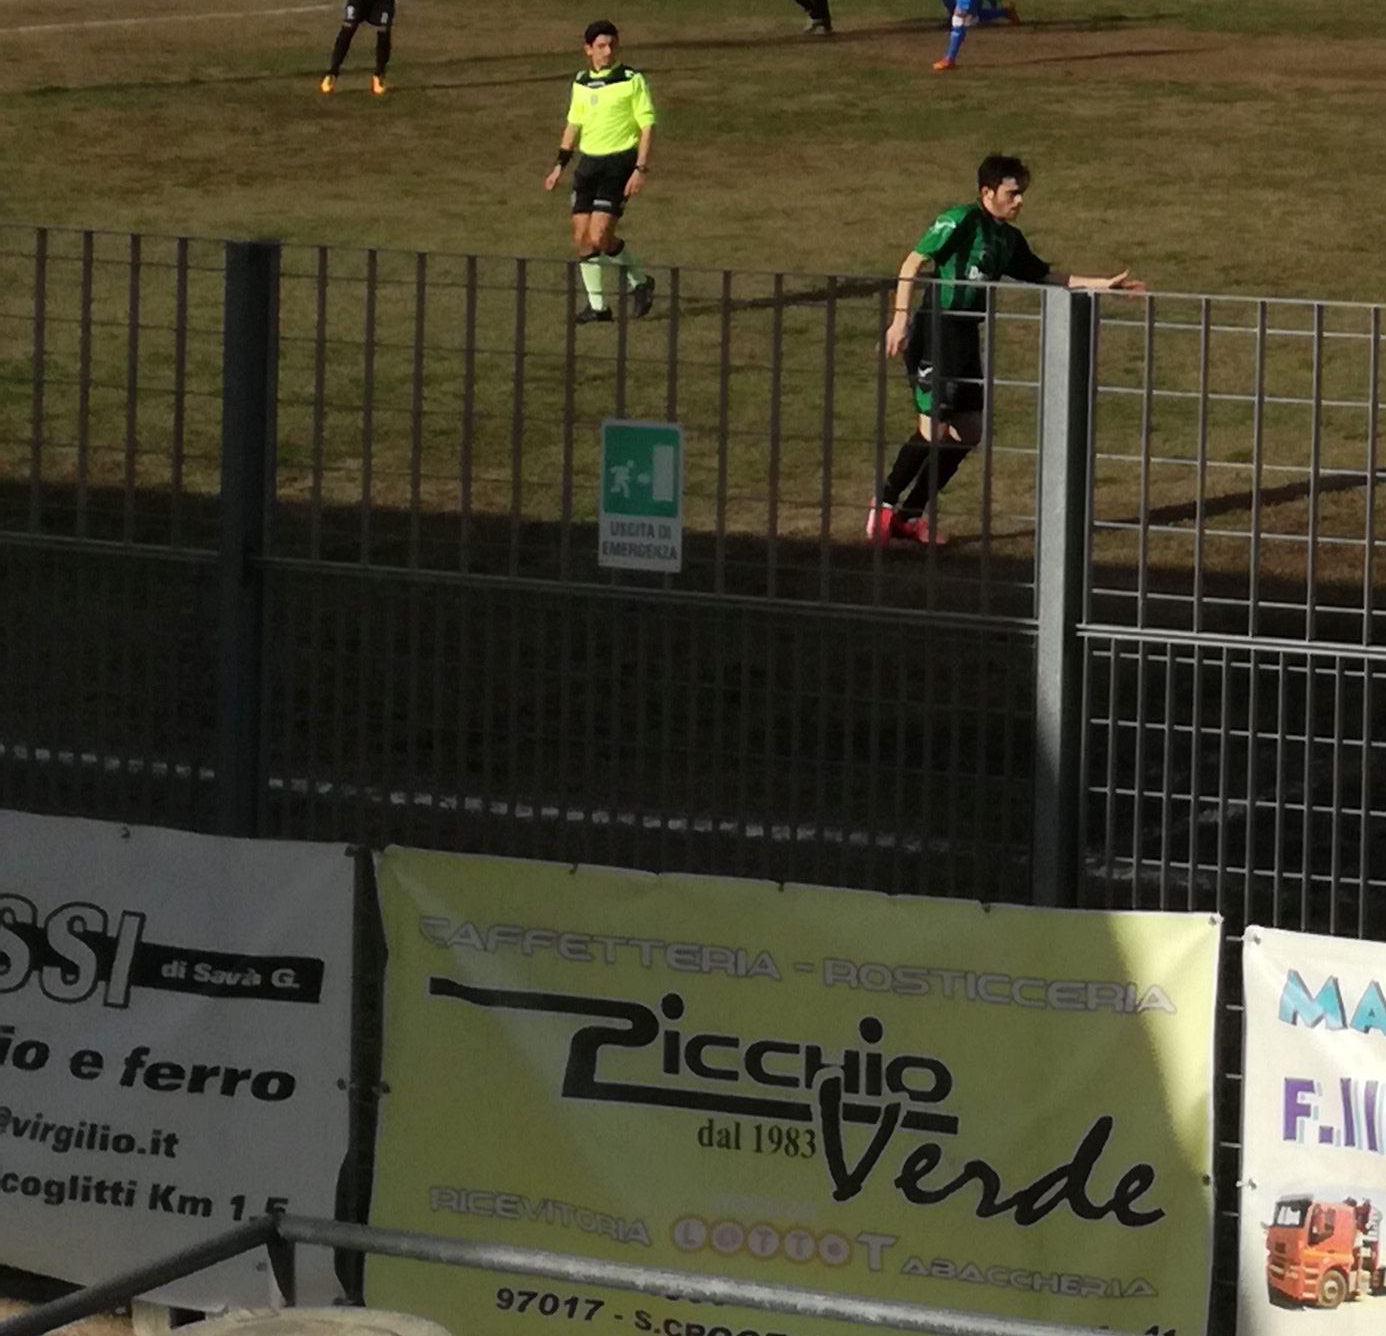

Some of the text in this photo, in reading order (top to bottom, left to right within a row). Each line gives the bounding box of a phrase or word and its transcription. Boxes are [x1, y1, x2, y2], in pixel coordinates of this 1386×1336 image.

[602, 540, 678, 561] EMERGENZA
[609, 521, 672, 540] USCITA DI
[419, 916, 783, 982] CAFFETTERIA
[822, 958, 1178, 1015] ROSTICCERIA
[69, 1049, 104, 1080] e
[119, 1046, 297, 1102] ferro
[697, 1119, 817, 1160] dal 1983
[815, 1076, 1166, 1228] Verde
[149, 1183, 212, 1218] Km
[429, 1187, 652, 1247] RICEVITORIA
[495, 1287, 606, 1323] 97017
